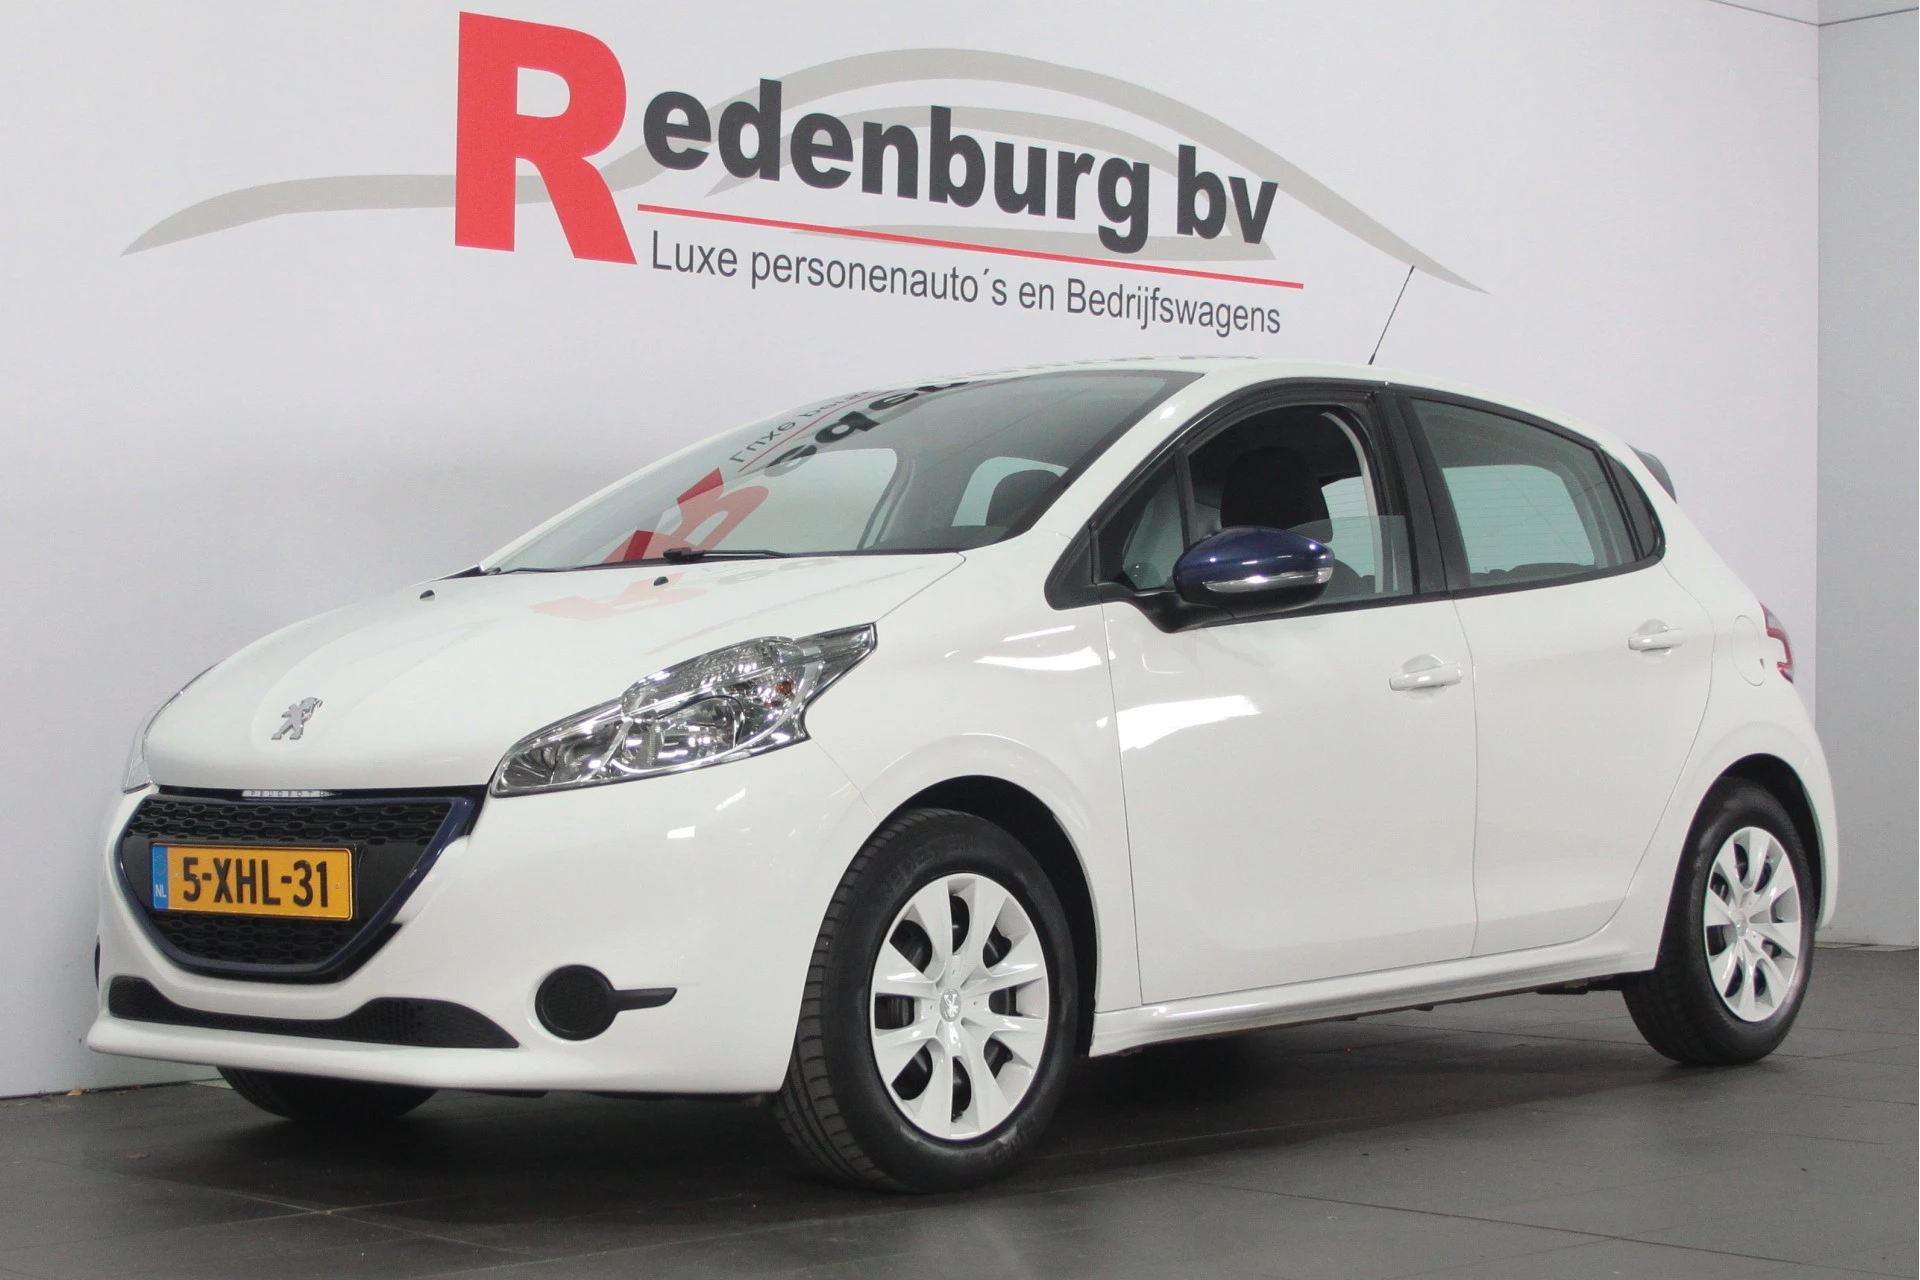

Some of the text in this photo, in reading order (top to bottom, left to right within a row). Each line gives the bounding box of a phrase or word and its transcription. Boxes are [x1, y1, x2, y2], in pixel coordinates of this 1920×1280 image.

[455, 11, 1279, 265] Redenburg bv
[652, 230, 738, 277] Luxe
[1018, 280, 1055, 311] en
[1067, 277, 1281, 338] Bedrijfswagens
[155, 884, 168, 898] NL
[182, 856, 329, 908] 5-XHL-31
